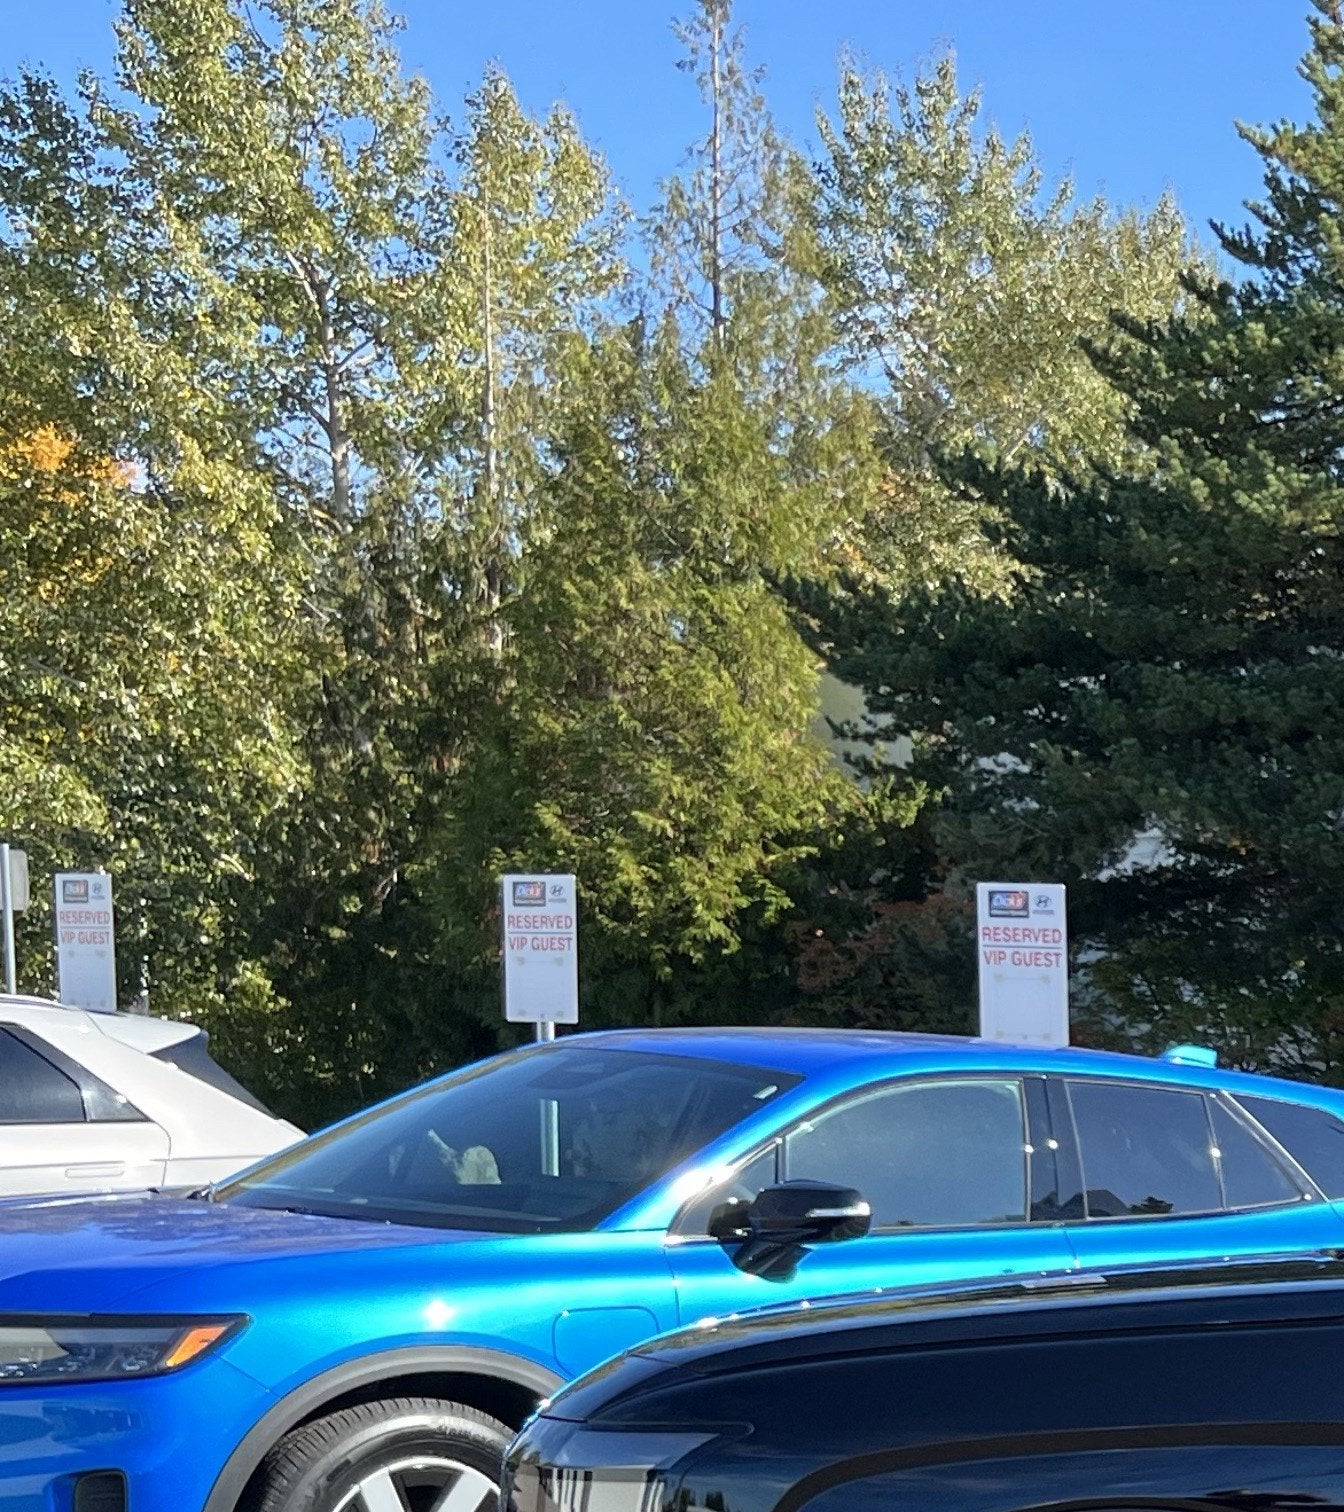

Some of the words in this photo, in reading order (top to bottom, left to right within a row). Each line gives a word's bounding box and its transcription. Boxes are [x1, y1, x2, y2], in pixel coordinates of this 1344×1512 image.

[59, 911, 110, 924] RESERVED
[508, 915, 573, 929] RESERVED
[60, 931, 75, 943] VIP
[79, 931, 109, 944] GUEST
[982, 927, 1062, 943] RESERVED
[509, 936, 527, 950] VIP
[531, 937, 573, 951] GUEST
[983, 950, 1006, 965] VIP
[1011, 951, 1062, 967] GUEST
